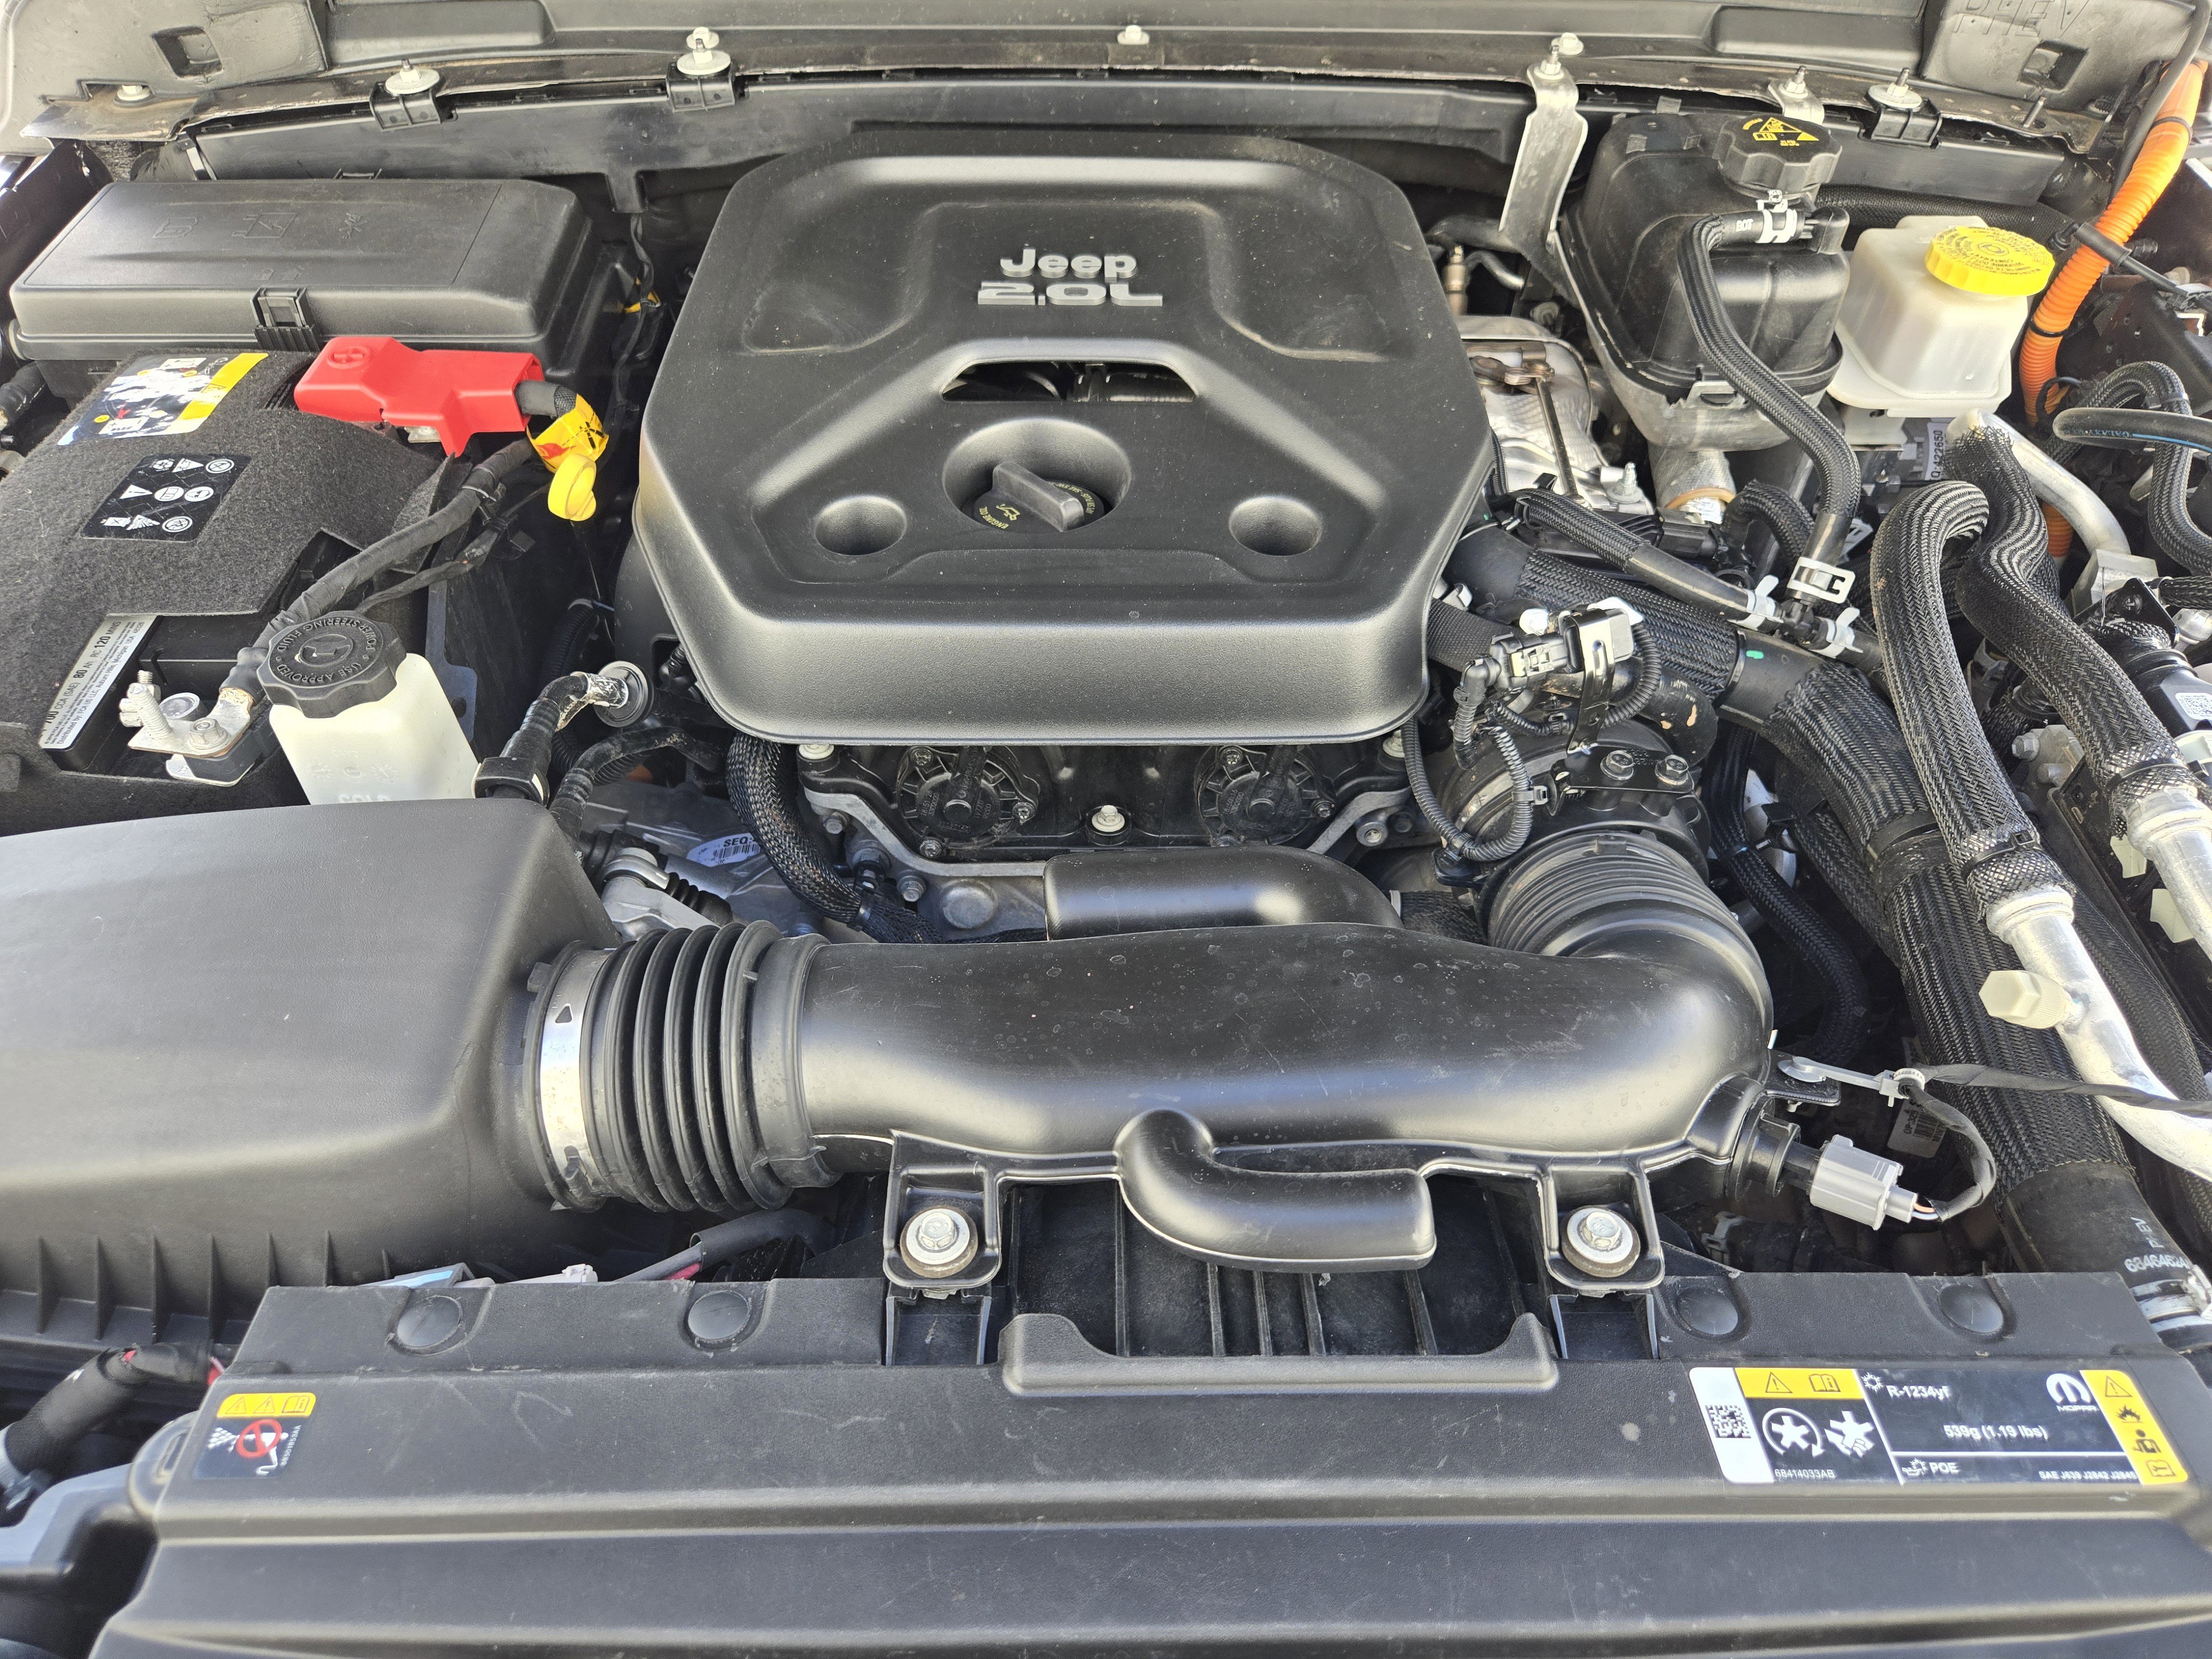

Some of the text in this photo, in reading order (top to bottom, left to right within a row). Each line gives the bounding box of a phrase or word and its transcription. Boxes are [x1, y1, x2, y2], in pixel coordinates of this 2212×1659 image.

[1000, 248, 1137, 283] Jeep
[978, 282, 1163, 306] 2.0L
[979, 506, 1009, 529] ENGINE OIL
[106, 621, 122, 635] MINS
[94, 636, 111, 649] 120
[90, 649, 102, 658] RC
[277, 617, 377, 684] USE APPROVED POWER STEERING FLUID
[73, 669, 87, 679] 80
[57, 721, 77, 745] Distributed
[78, 703, 88, 714] FCA
[112, 645, 130, 664] Michigan
[125, 635, 135, 645] USA
[64, 681, 81, 700] (SAE)
[54, 696, 67, 710] CCA
[1886, 1384, 1950, 1401] R-1234yf
[1944, 1425, 2049, 1439] 539g (1.19 lbs)
[280, 1425, 302, 1466] 68501853AA
[1774, 1468, 1836, 1480] 68414033AB
[1929, 1462, 1960, 1474] POE
[2039, 1470, 2059, 1480] SAE
[2060, 1471, 2081, 1480] J639
